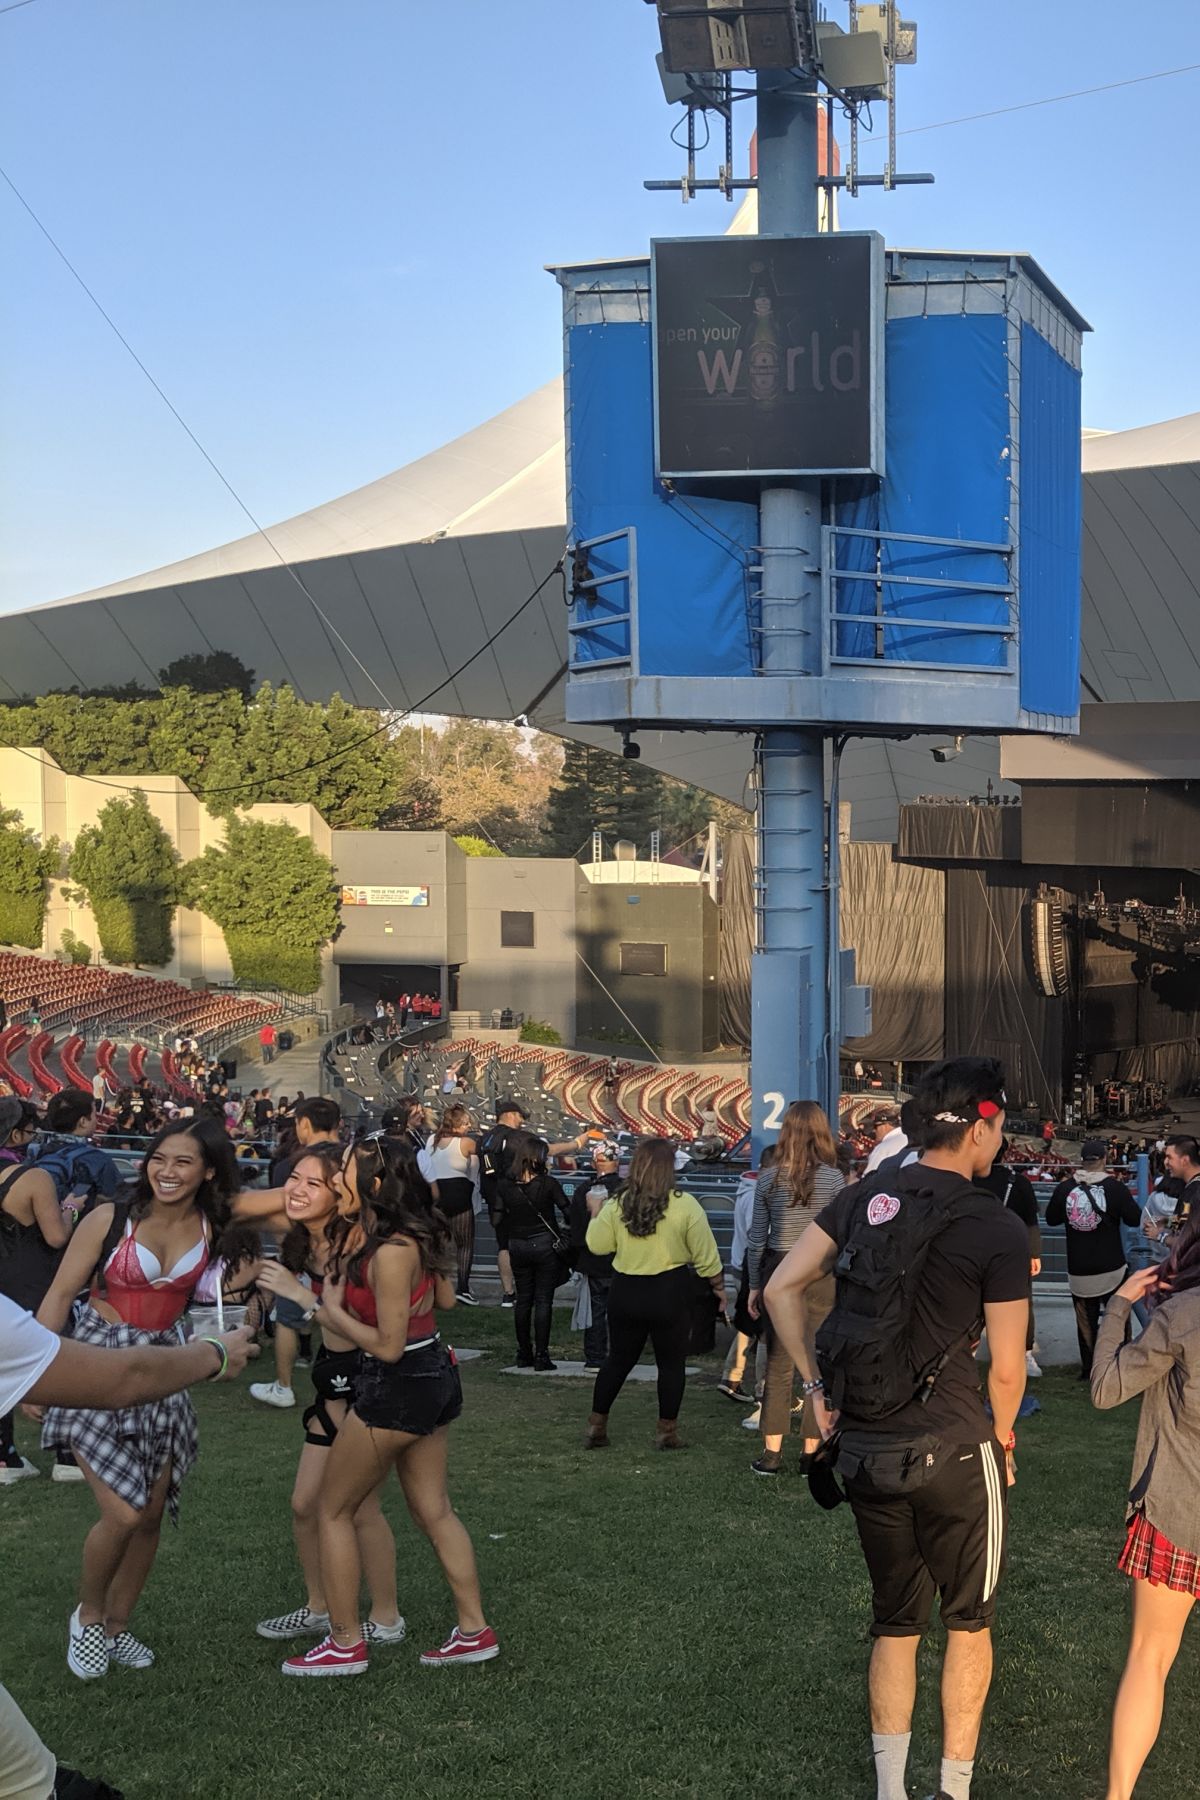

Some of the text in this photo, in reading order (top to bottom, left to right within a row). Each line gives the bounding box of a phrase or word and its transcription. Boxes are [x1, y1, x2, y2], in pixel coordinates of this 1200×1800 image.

[702, 326, 738, 343] your
[697, 329, 861, 394] wrld
[763, 1091, 785, 1130] 2
